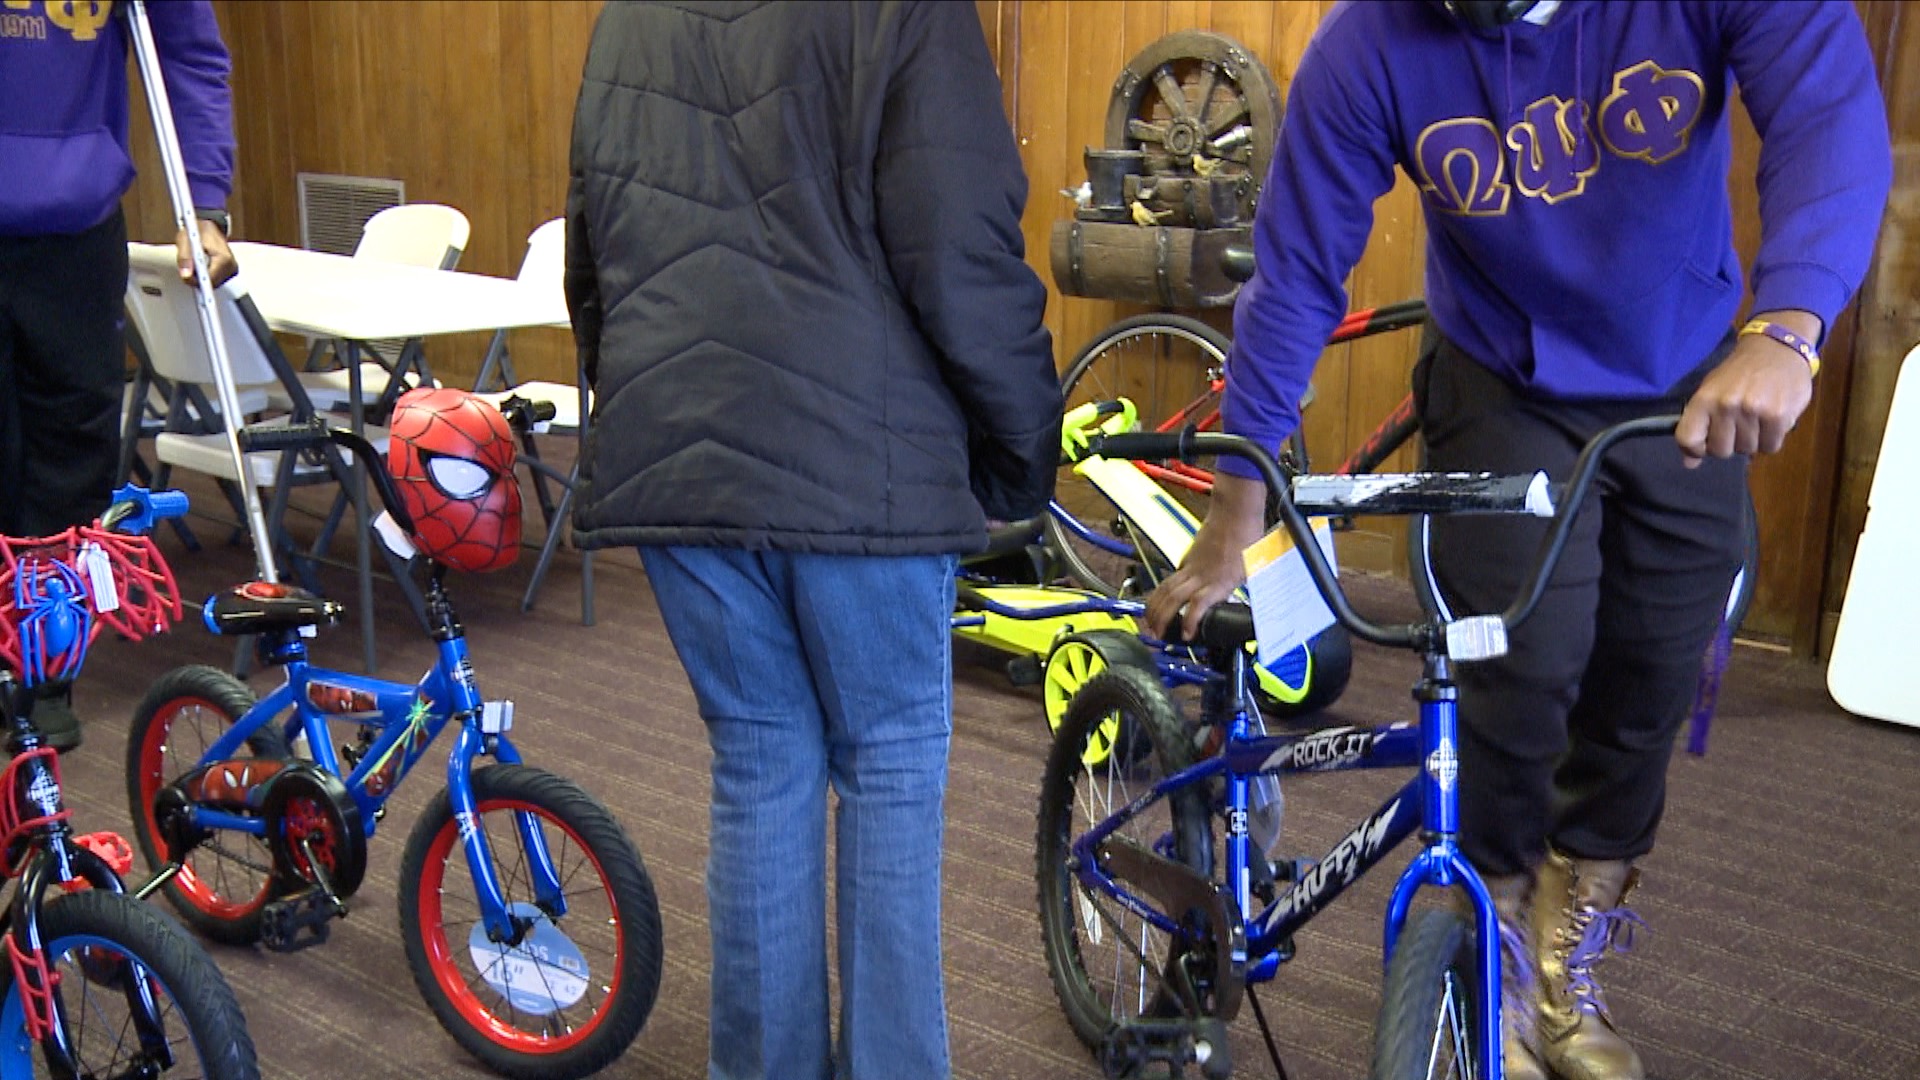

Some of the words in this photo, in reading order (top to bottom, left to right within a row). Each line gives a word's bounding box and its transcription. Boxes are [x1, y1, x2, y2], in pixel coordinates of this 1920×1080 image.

[0, 14, 46, 39] 1911
[1294, 735, 1341, 768] ROCK
[1344, 732, 1371, 756] IT
[1293, 817, 1371, 913] HUFFY
